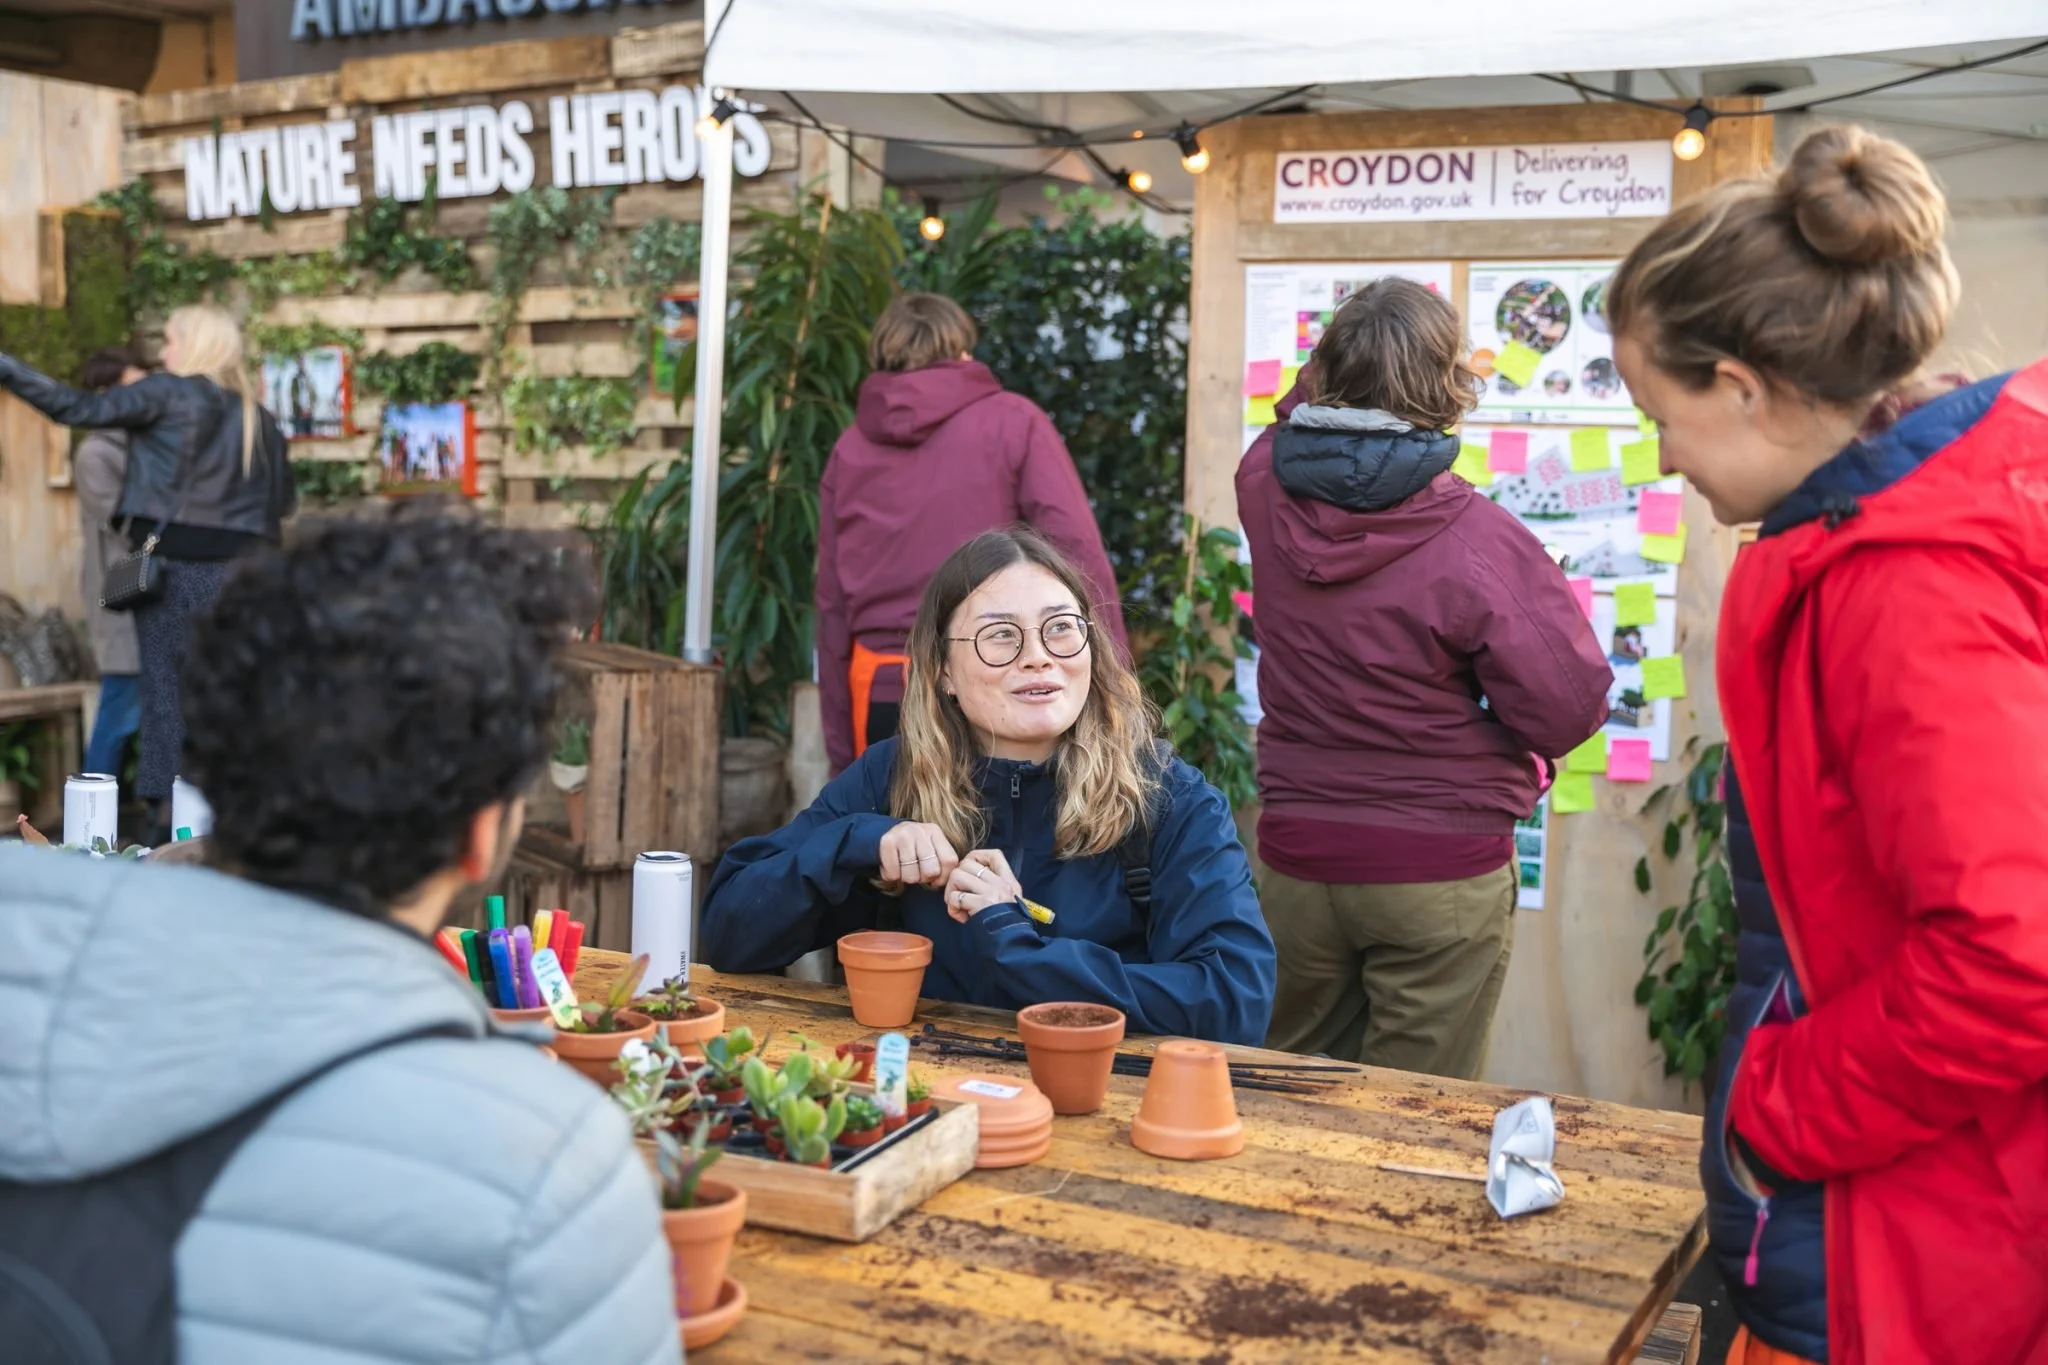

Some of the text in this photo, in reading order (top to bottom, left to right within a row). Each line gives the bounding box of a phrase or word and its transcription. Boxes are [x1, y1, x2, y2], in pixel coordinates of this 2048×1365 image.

[185, 119, 361, 221] NATURE
[549, 84, 771, 188] HEROS
[1281, 152, 1474, 188] CROYDON
[1513, 147, 1629, 182] Delivering
[1280, 191, 1473, 214] www.croydon.gov.uk
[1512, 177, 1666, 215] for Croydon
